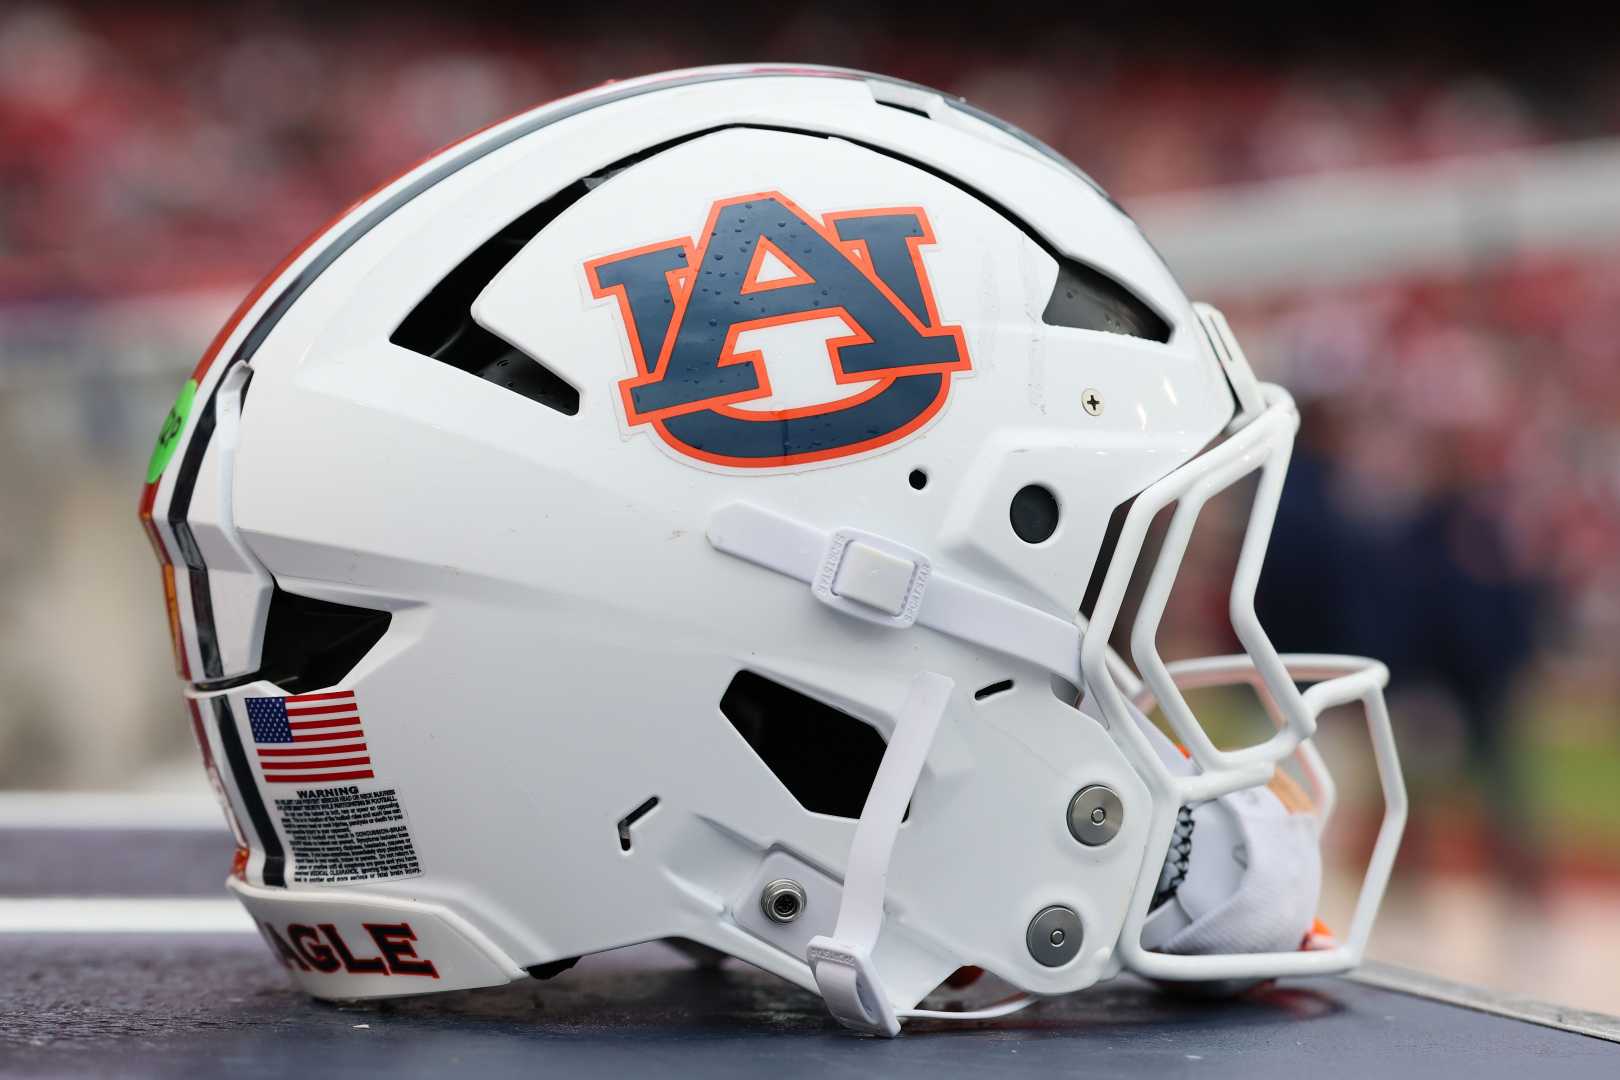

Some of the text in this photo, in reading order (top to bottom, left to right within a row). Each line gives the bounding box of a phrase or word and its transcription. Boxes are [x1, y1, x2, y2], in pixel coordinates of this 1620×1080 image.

[583, 190, 972, 468] AU
[296, 786, 359, 799] WARNING
[371, 796, 398, 804] FOOTBALL.
[377, 802, 399, 810] opposing
